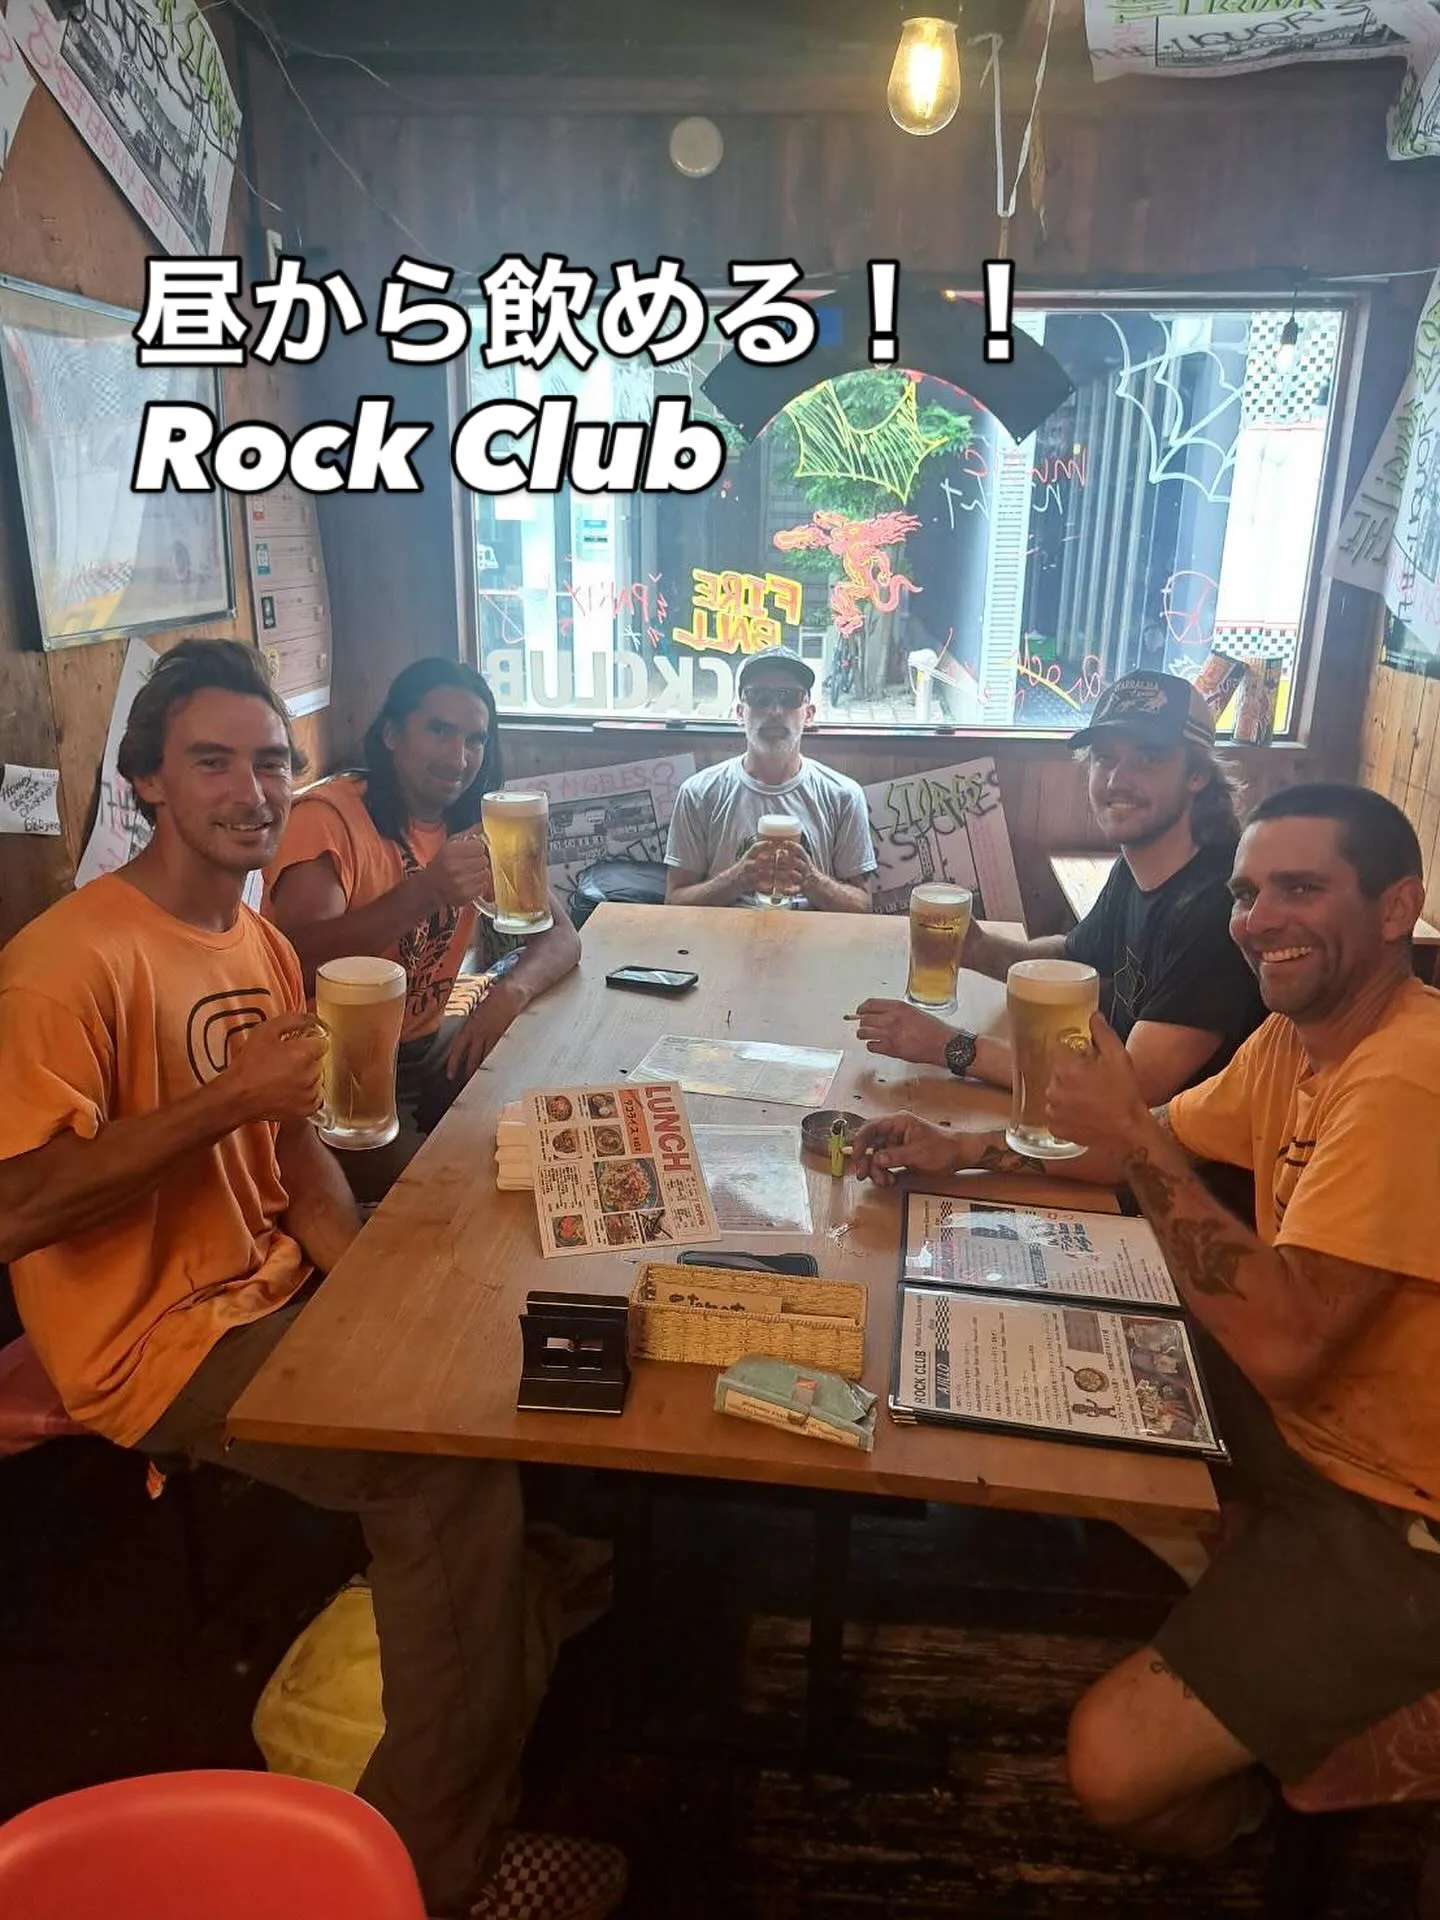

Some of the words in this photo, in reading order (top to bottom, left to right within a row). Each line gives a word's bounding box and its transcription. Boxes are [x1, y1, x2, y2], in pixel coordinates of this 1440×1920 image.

[644, 1086, 692, 1172] LUNCH
[916, 1349, 926, 1373] CLUB
[914, 1374, 926, 1405] ROCK
